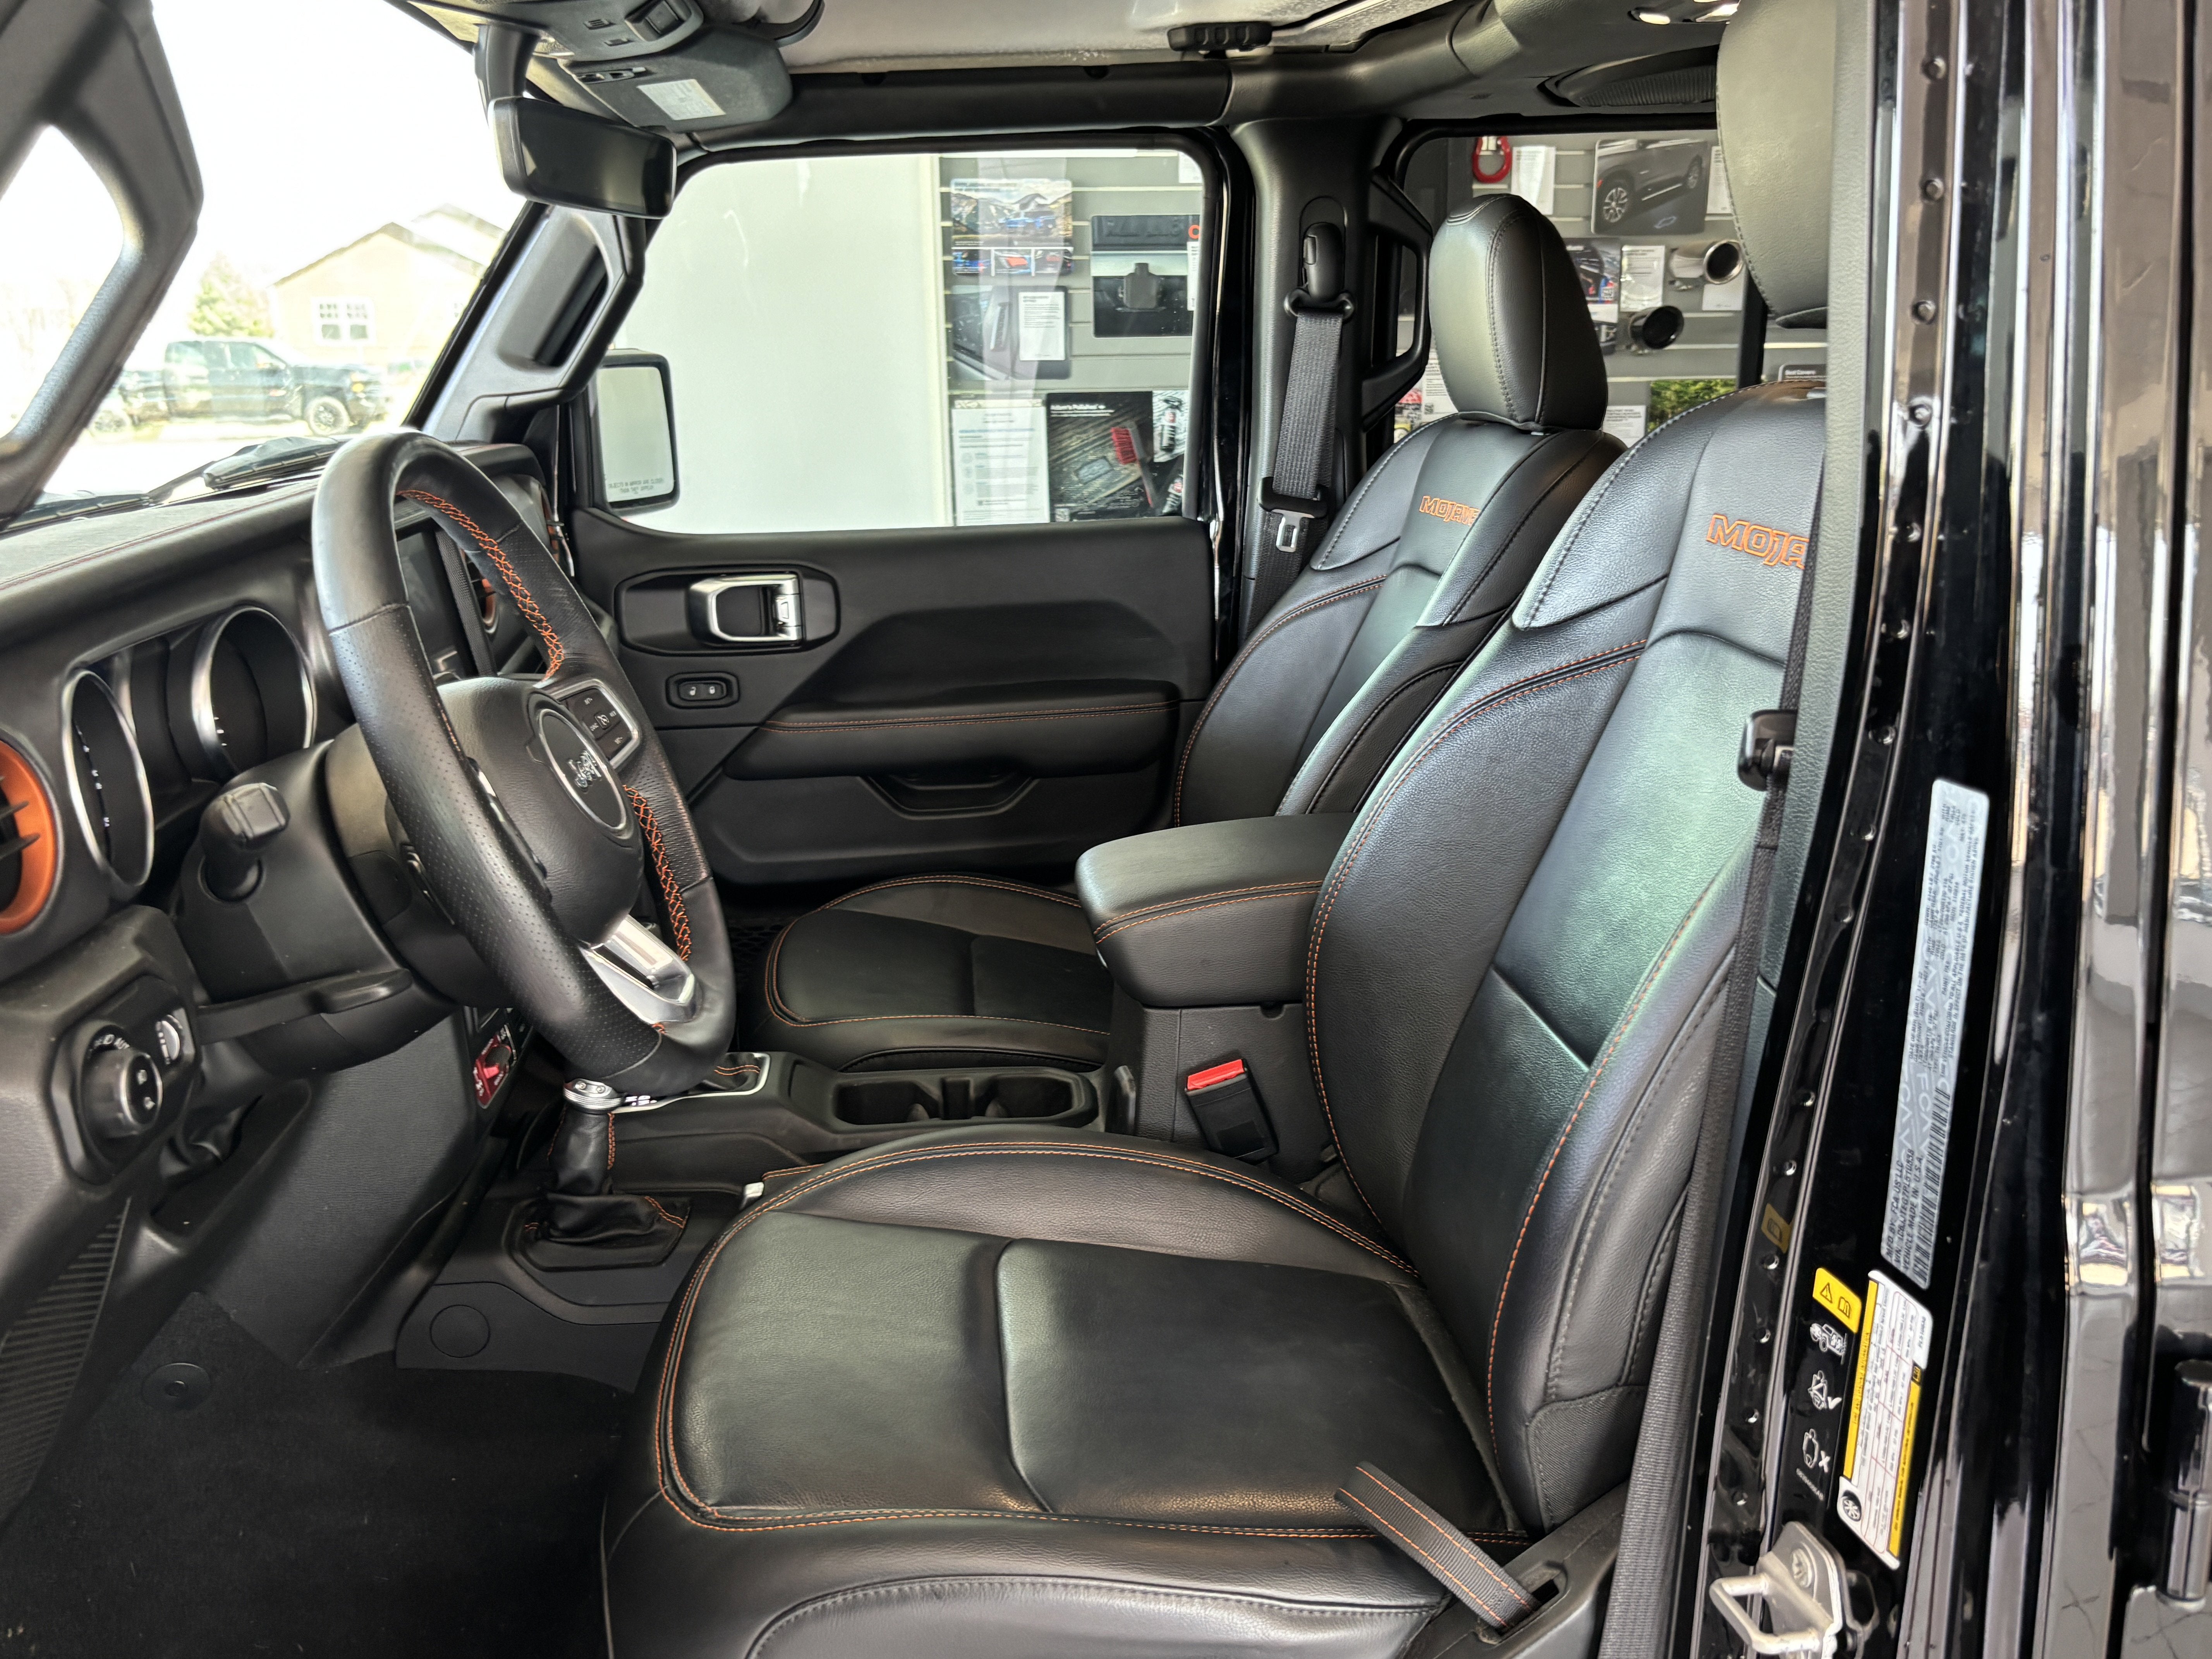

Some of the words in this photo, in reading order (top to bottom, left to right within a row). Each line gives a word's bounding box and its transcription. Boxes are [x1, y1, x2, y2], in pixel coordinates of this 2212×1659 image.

[1706, 513, 1809, 570] MOJA
[1895, 1159, 1903, 1178] LLC
[1893, 1178, 1901, 1194] US
[1891, 1194, 1899, 1214] FCA
[1907, 1200, 1917, 1230] MADE
[1902, 1230, 1913, 1271] VEHICLE
